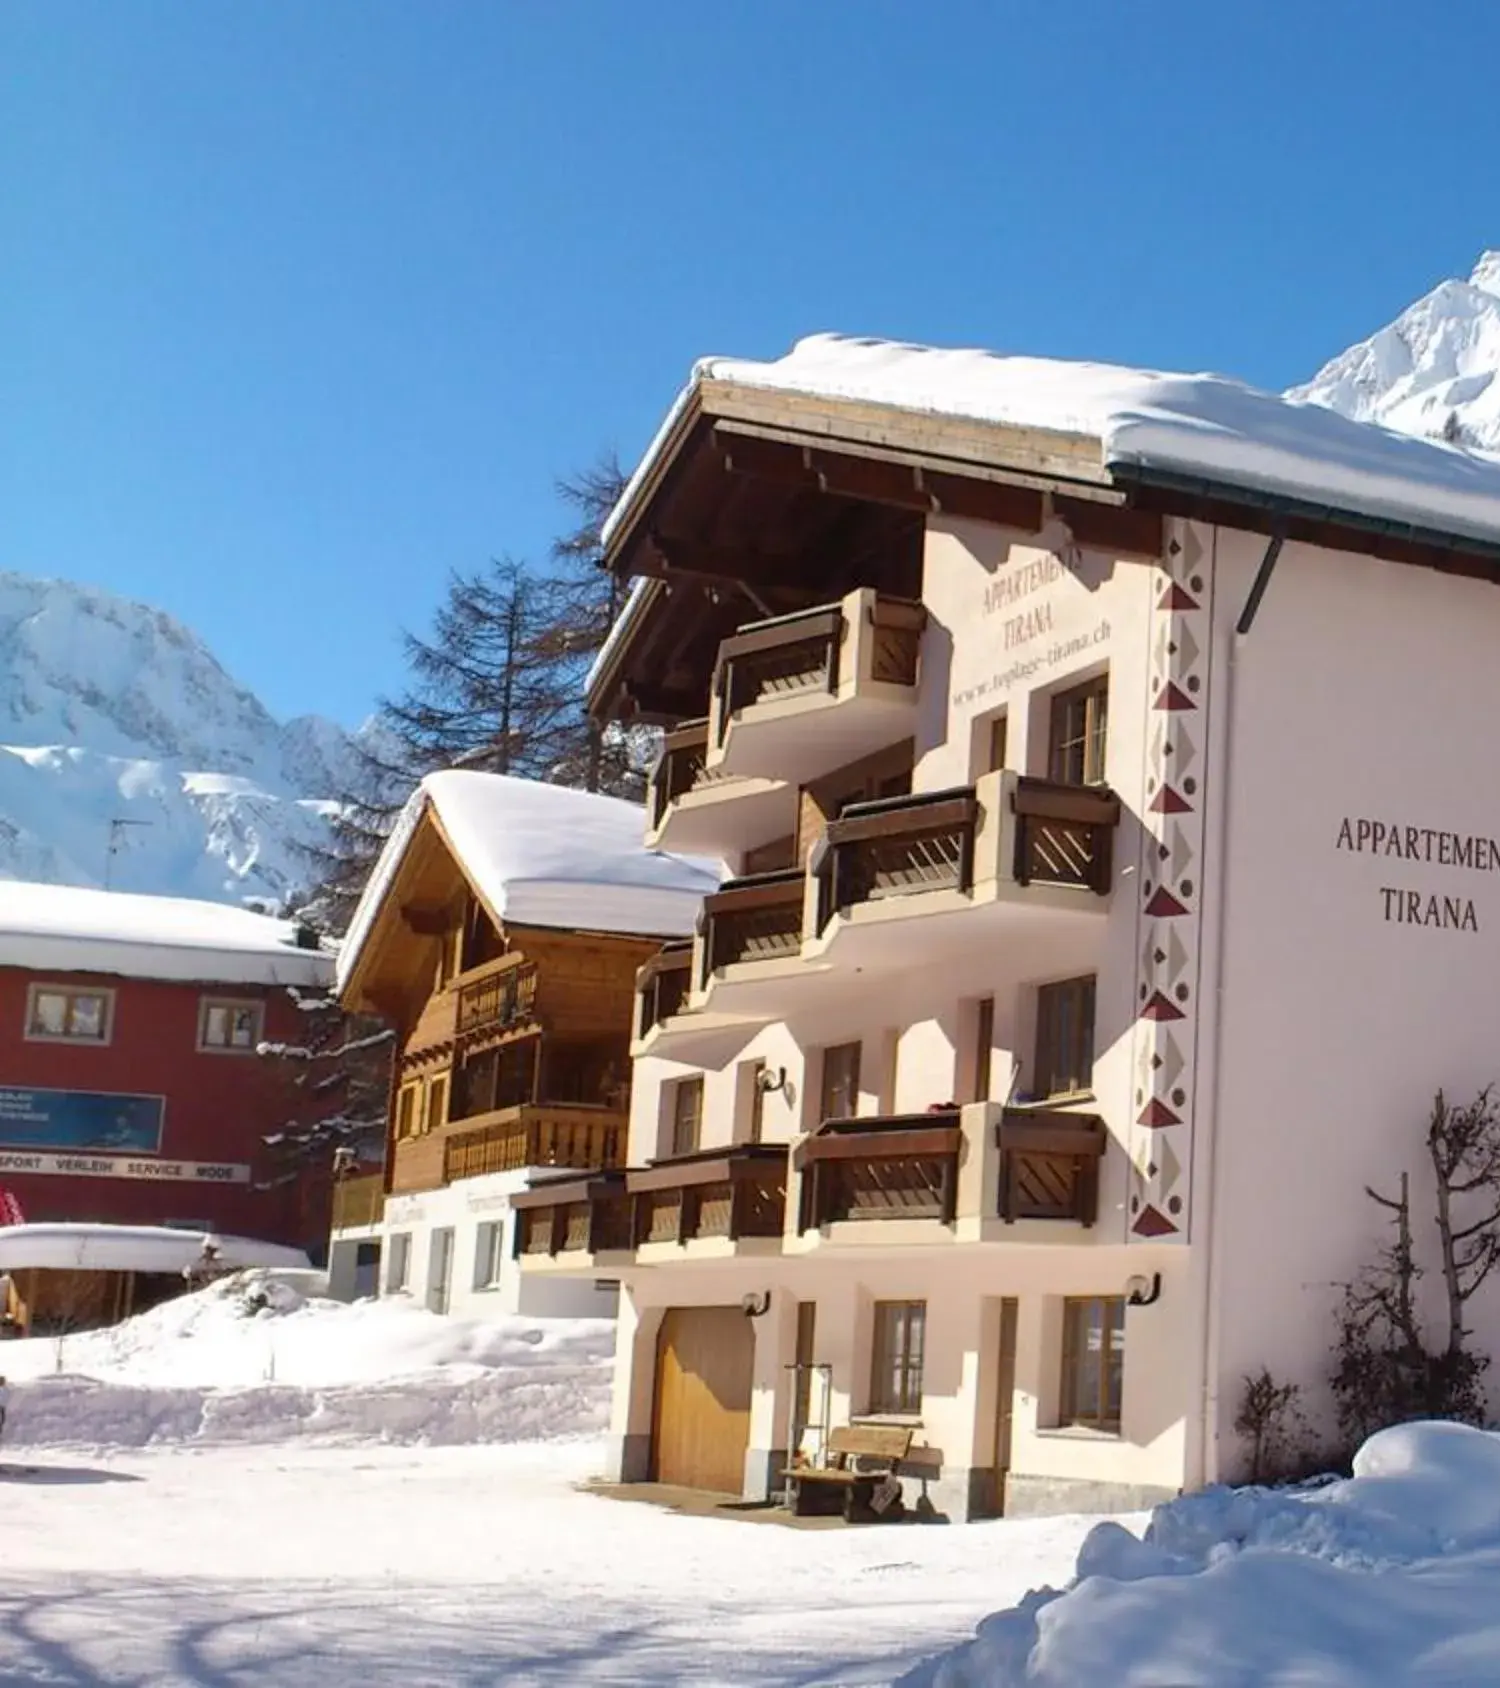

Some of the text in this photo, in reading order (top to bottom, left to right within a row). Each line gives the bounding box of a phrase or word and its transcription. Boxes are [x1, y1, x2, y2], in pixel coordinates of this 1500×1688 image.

[1003, 601, 1057, 651] TIRANA
[1379, 886, 1479, 933] TIRANA
[55, 1159, 113, 1173] VERLEIH
[127, 1162, 182, 1176] SERVICE
[195, 1166, 234, 1180] MODE
